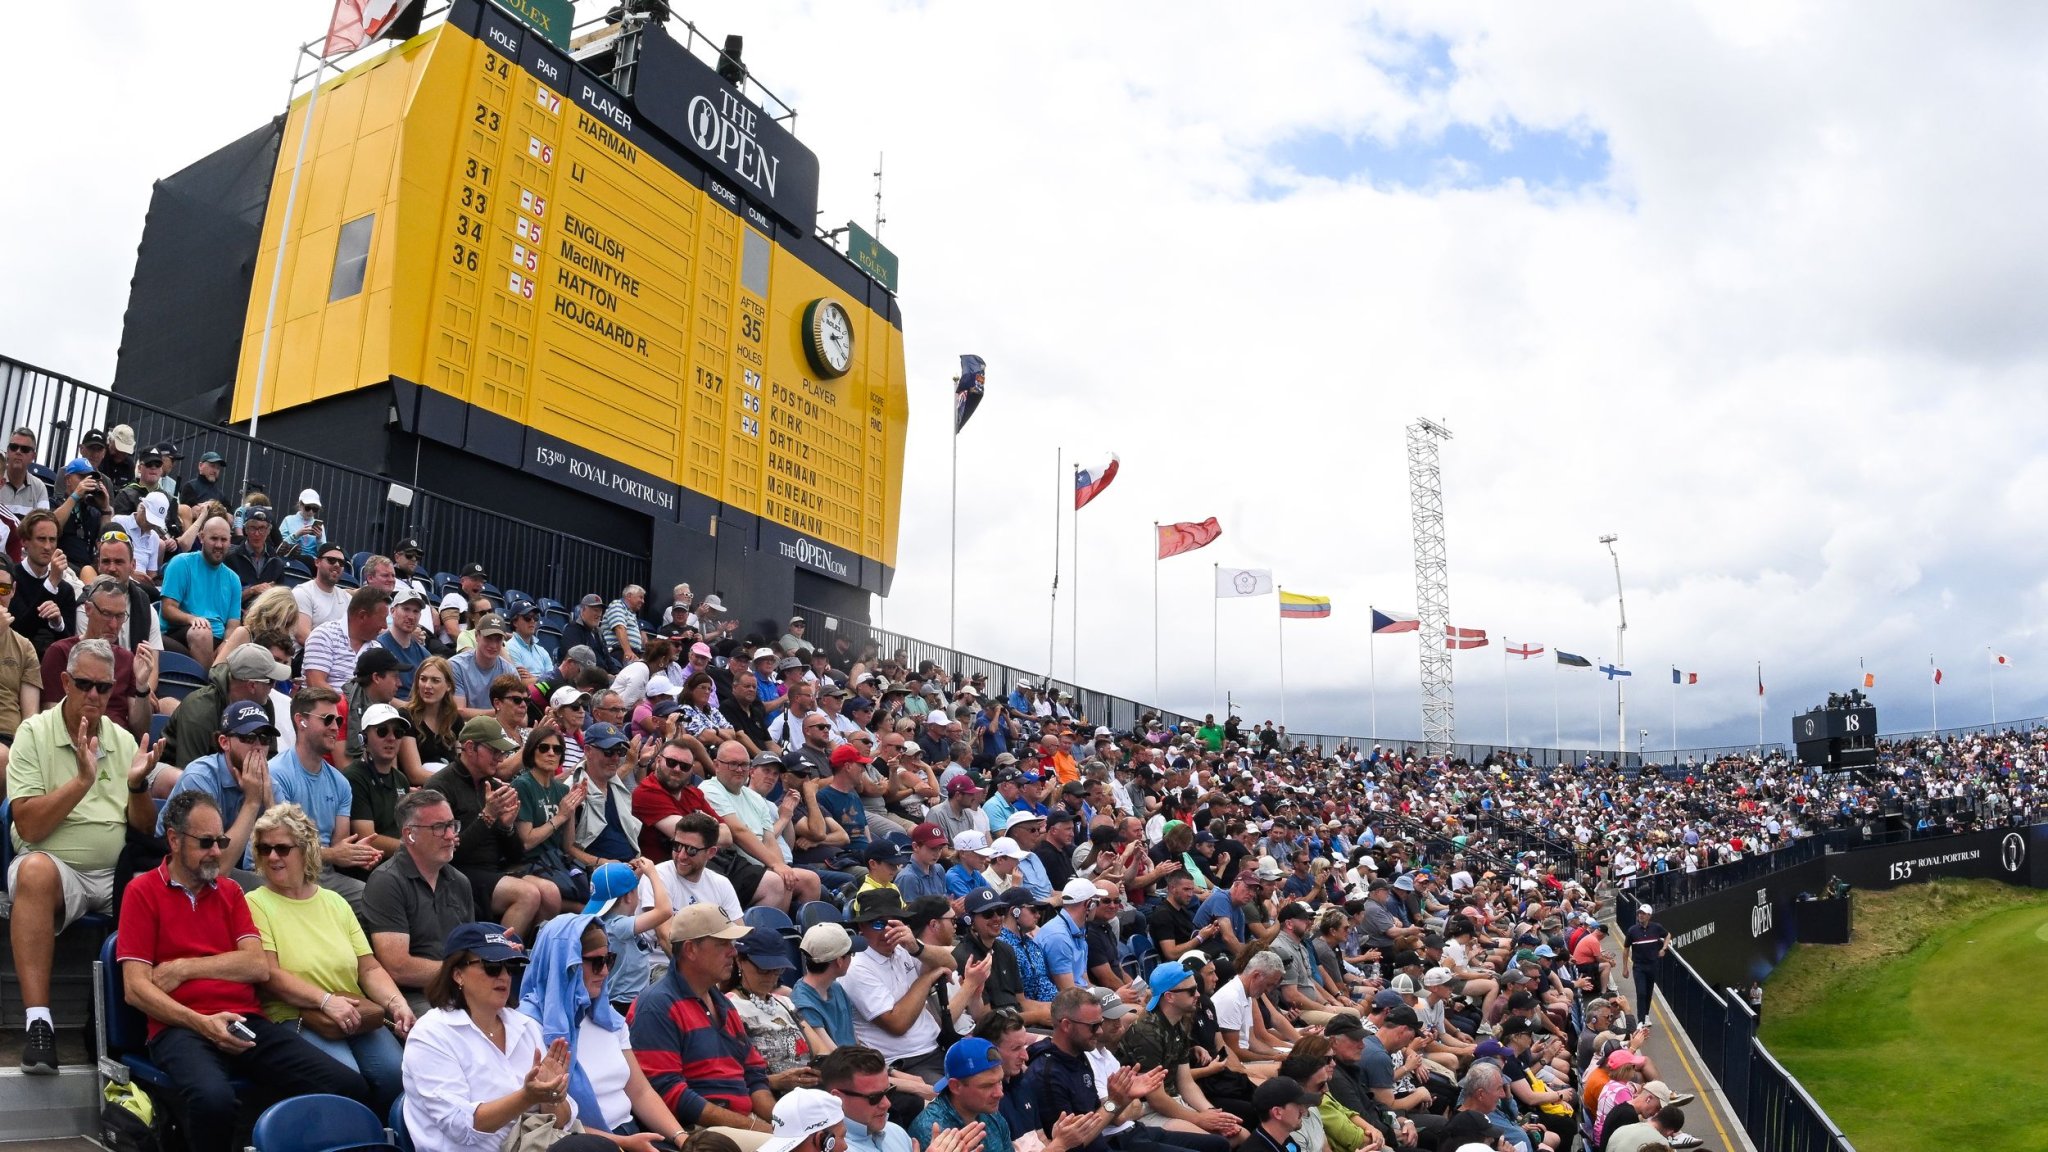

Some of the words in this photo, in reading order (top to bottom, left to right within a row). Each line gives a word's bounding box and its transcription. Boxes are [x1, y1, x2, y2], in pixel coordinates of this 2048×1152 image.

[505, 0, 550, 31] OLEX
[485, 54, 509, 81] 34
[538, 93, 560, 113] -7
[578, 113, 637, 164] HARMAN
[489, 26, 517, 53] HOLE
[537, 58, 558, 81] PAR
[582, 85, 632, 131] PLAYER
[711, 181, 736, 205] SCORE
[748, 207, 769, 228] CUML
[719, 88, 757, 138] THE
[474, 105, 500, 132] 23
[531, 143, 552, 164] -6
[571, 163, 585, 184] LI
[687, 95, 780, 199] OPEN
[466, 159, 490, 186] 31
[523, 196, 544, 217] -5
[564, 214, 625, 263] ENGLISH
[461, 185, 486, 214] 33
[519, 222, 540, 243] -5
[560, 240, 641, 298] MacINTYRE
[457, 215, 482, 243] 34
[515, 250, 537, 271] -5
[558, 268, 617, 313] HATTON
[859, 251, 888, 281] ROLEX
[452, 244, 478, 272] 36
[511, 278, 533, 299] -5
[554, 296, 634, 349] HOJGAARD
[636, 339, 649, 358] R.
[740, 296, 765, 317] AFTER
[741, 314, 761, 344] 35
[736, 343, 762, 366] HOLES
[696, 366, 723, 394] 137
[745, 370, 760, 388] +7
[772, 382, 818, 420] POSTON
[803, 378, 836, 407] PLAYER
[744, 395, 759, 413] +6
[770, 405, 803, 435] KIRK
[742, 419, 758, 436] +4
[769, 428, 810, 460] ORTIZ
[536, 446, 566, 467] 153RD
[569, 457, 609, 487] ROYAL
[612, 474, 673, 510] PORTRUSH
[768, 452, 817, 487] HARMAN
[767, 475, 823, 512] McNEALY
[766, 499, 823, 536] NIEMANN
[1845, 713, 1860, 732] 18
[1918, 856, 1941, 868] ROYAL
[1942, 849, 1980, 864] PORTRUSH
[1756, 887, 1767, 903] THE
[1751, 903, 1773, 938] OPEN
[805, 1119, 829, 1131] APEX
